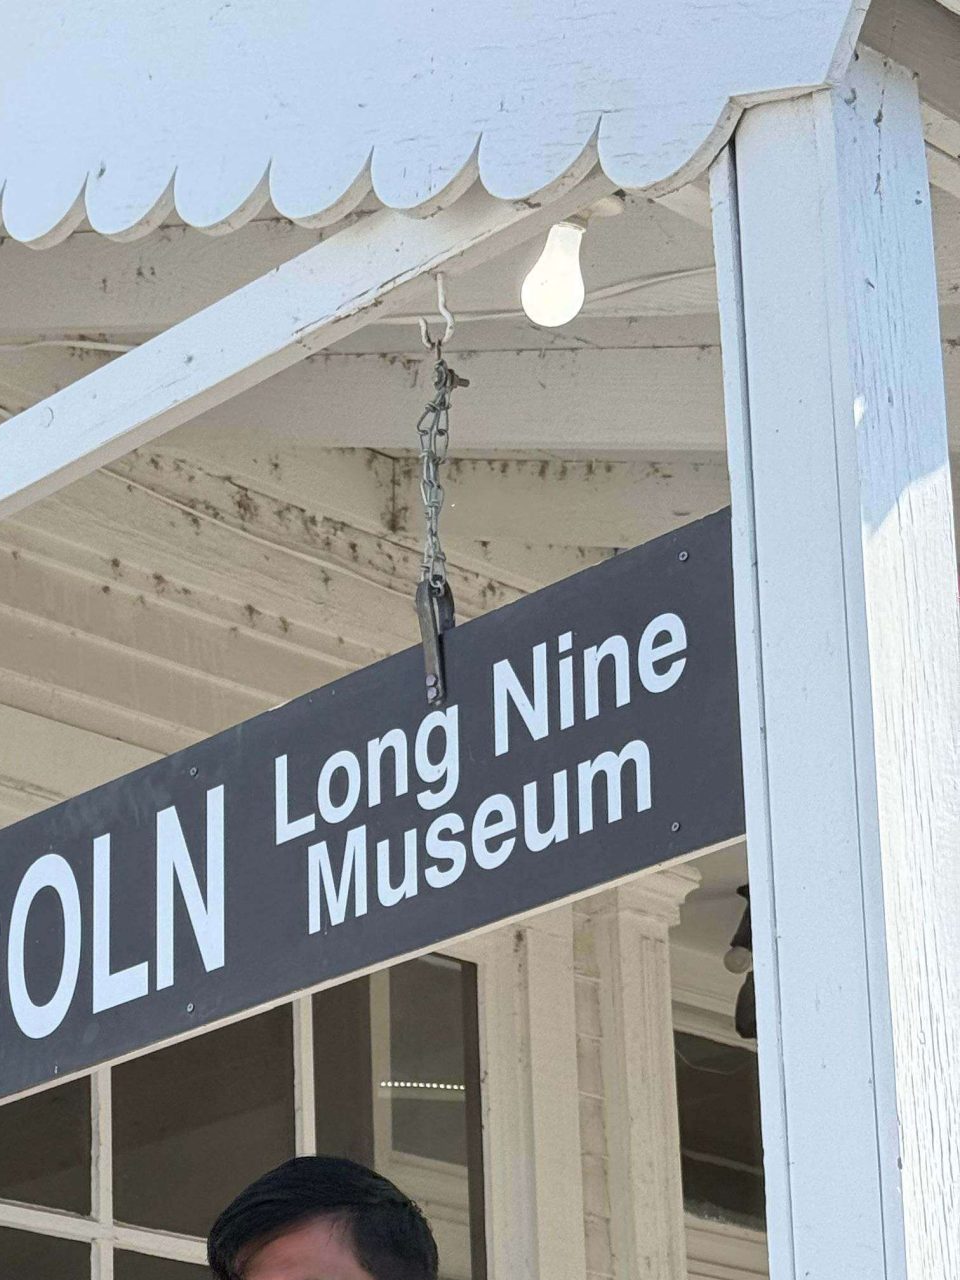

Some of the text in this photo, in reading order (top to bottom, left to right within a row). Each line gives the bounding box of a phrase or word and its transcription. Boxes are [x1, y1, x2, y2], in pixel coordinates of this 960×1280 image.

[275, 613, 688, 845] Long Nine
[308, 740, 652, 935] Museum
